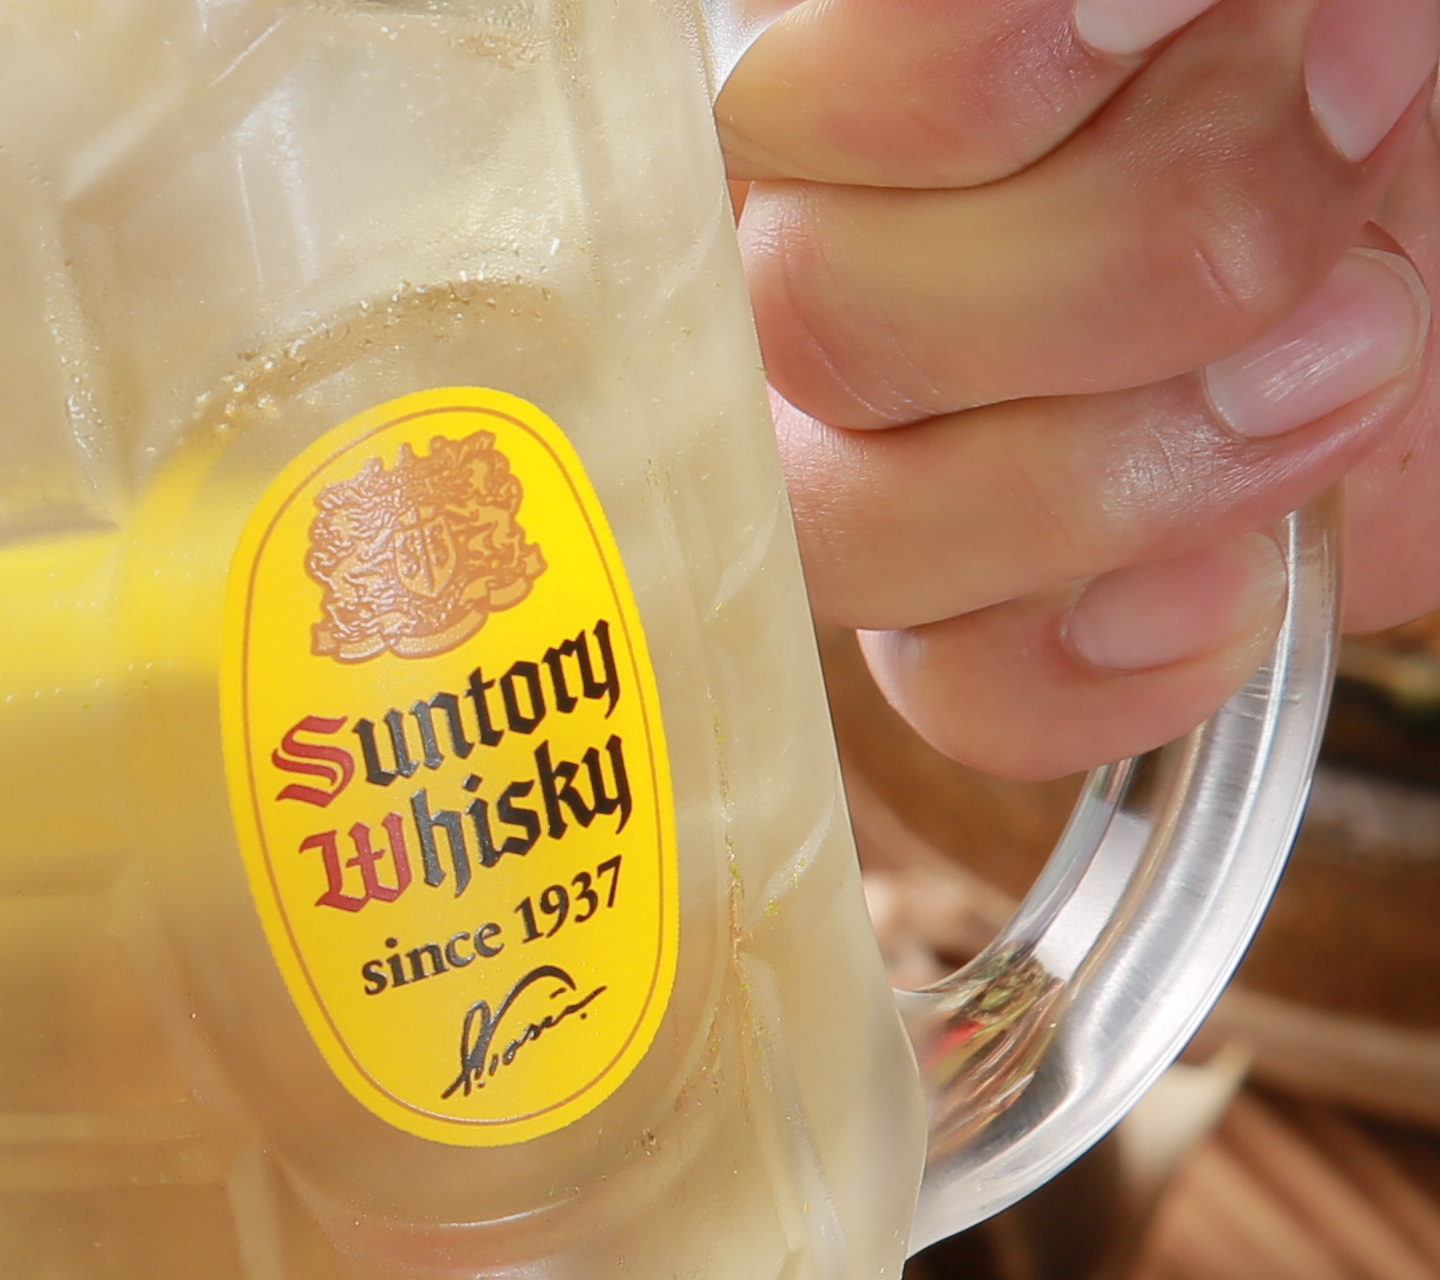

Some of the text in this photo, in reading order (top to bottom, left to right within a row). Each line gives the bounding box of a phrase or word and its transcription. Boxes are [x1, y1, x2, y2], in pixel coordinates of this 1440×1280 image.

[271, 619, 621, 808] Suntory
[298, 733, 633, 913] Whisky
[361, 854, 622, 996] since 1937
